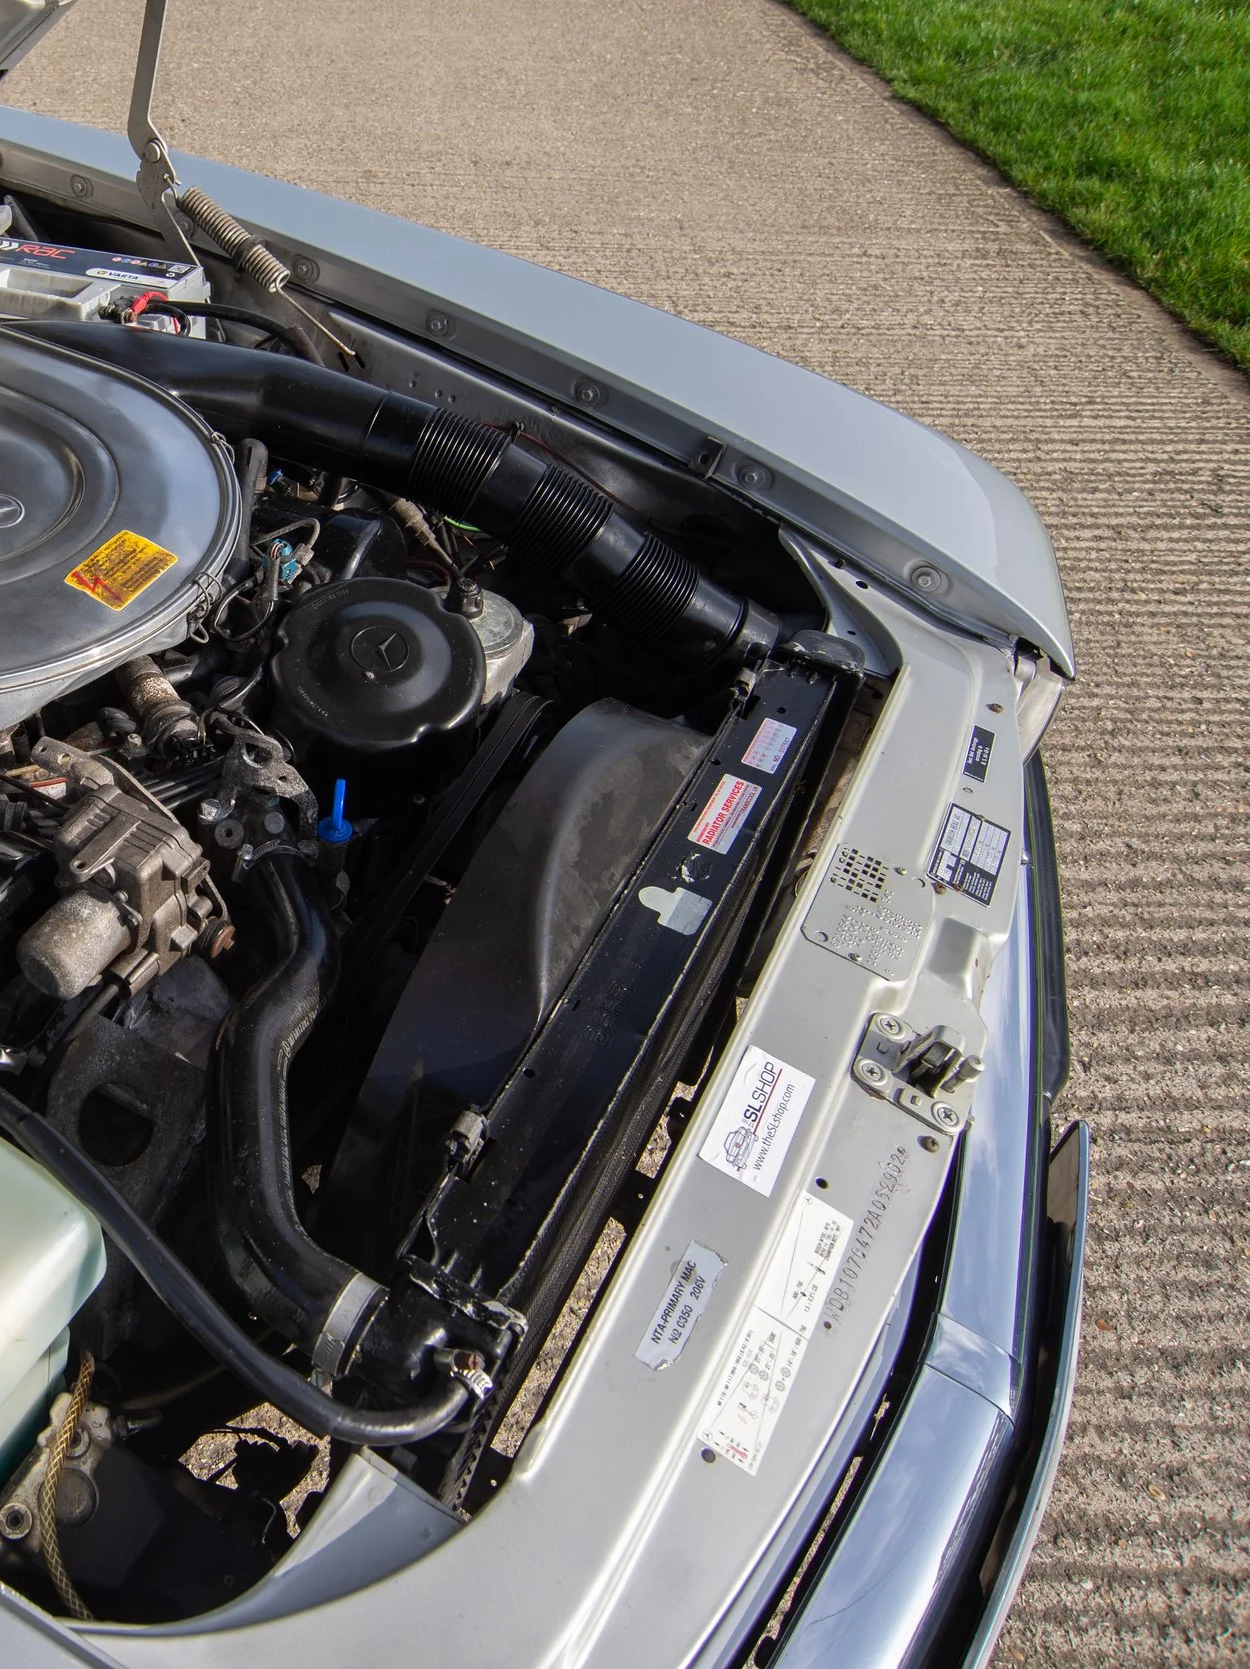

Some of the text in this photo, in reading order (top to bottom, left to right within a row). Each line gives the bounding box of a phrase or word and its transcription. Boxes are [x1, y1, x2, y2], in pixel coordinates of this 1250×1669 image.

[702, 812, 726, 844] RADIATOR
[721, 780, 744, 811] SERVICES
[752, 1083, 796, 1171] www.theSLshop.com
[650, 1259, 696, 1344] NTA-PRIMARY MAC
[689, 1275, 706, 1300] 206V
